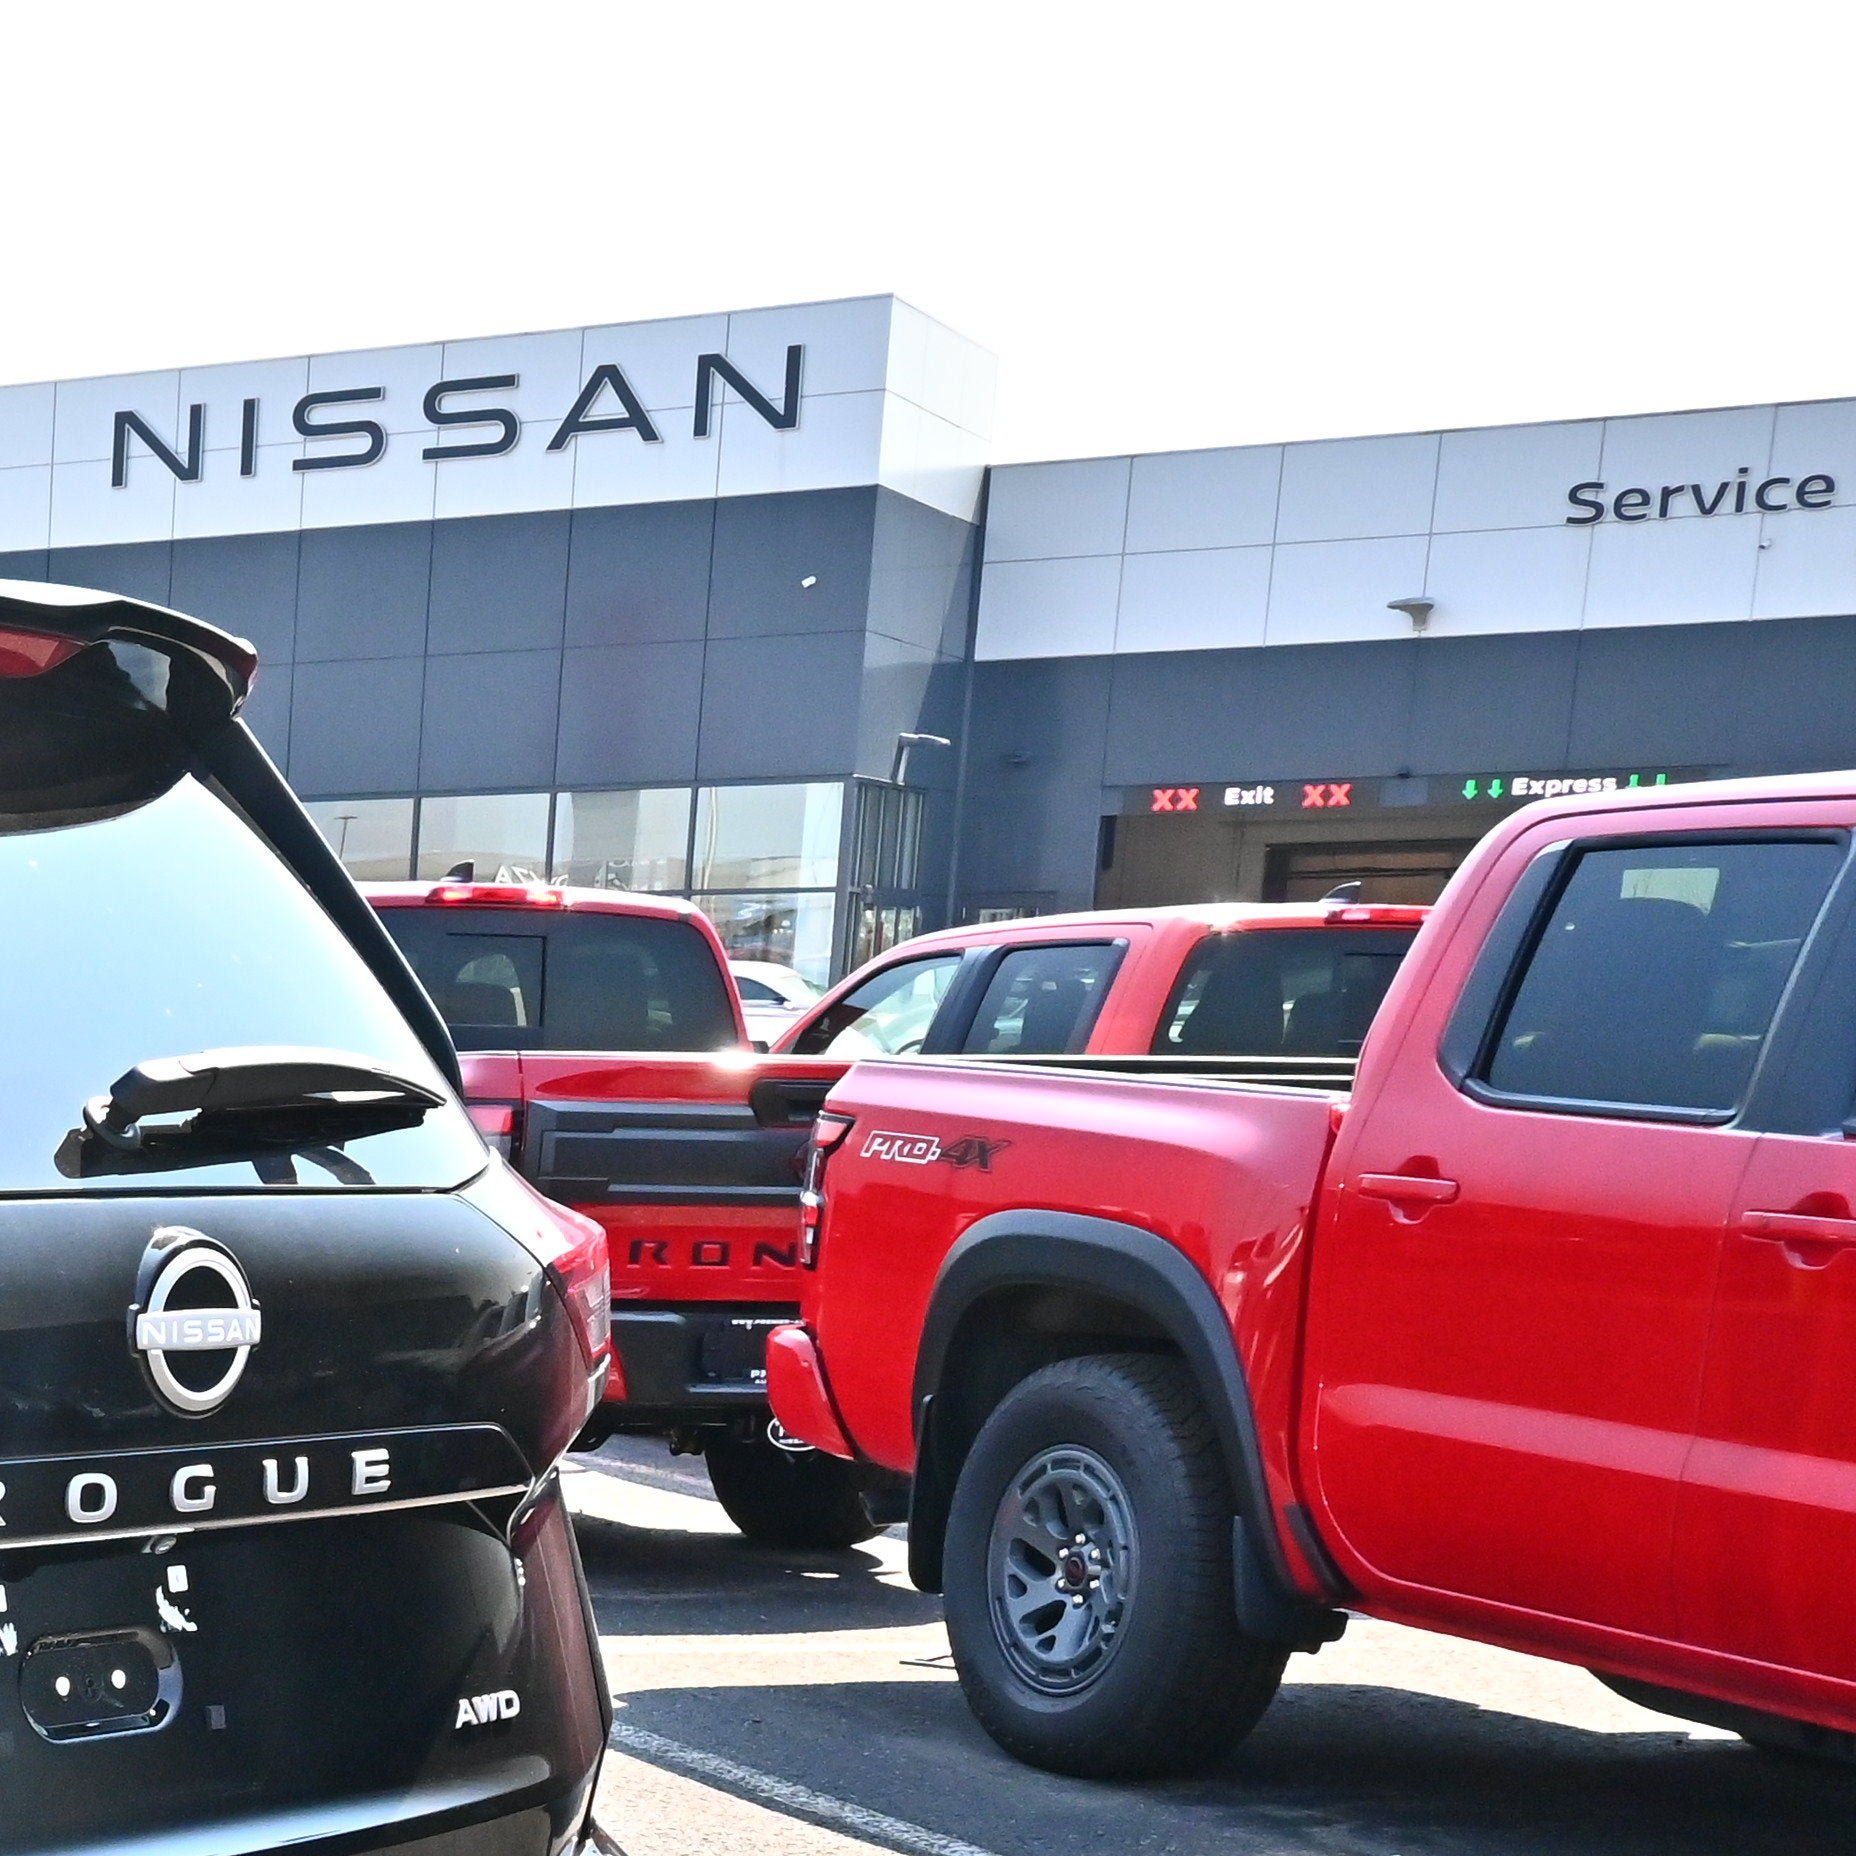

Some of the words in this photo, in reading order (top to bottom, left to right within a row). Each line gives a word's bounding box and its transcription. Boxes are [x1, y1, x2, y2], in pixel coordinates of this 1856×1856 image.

[110, 343, 806, 489] NISSAN
[1564, 466, 1836, 525] Service
[1223, 785, 1275, 806] Exit
[1510, 777, 1617, 797] Express
[141, 1317, 261, 1346] NISSAN
[454, 1689, 521, 1730] AWD
